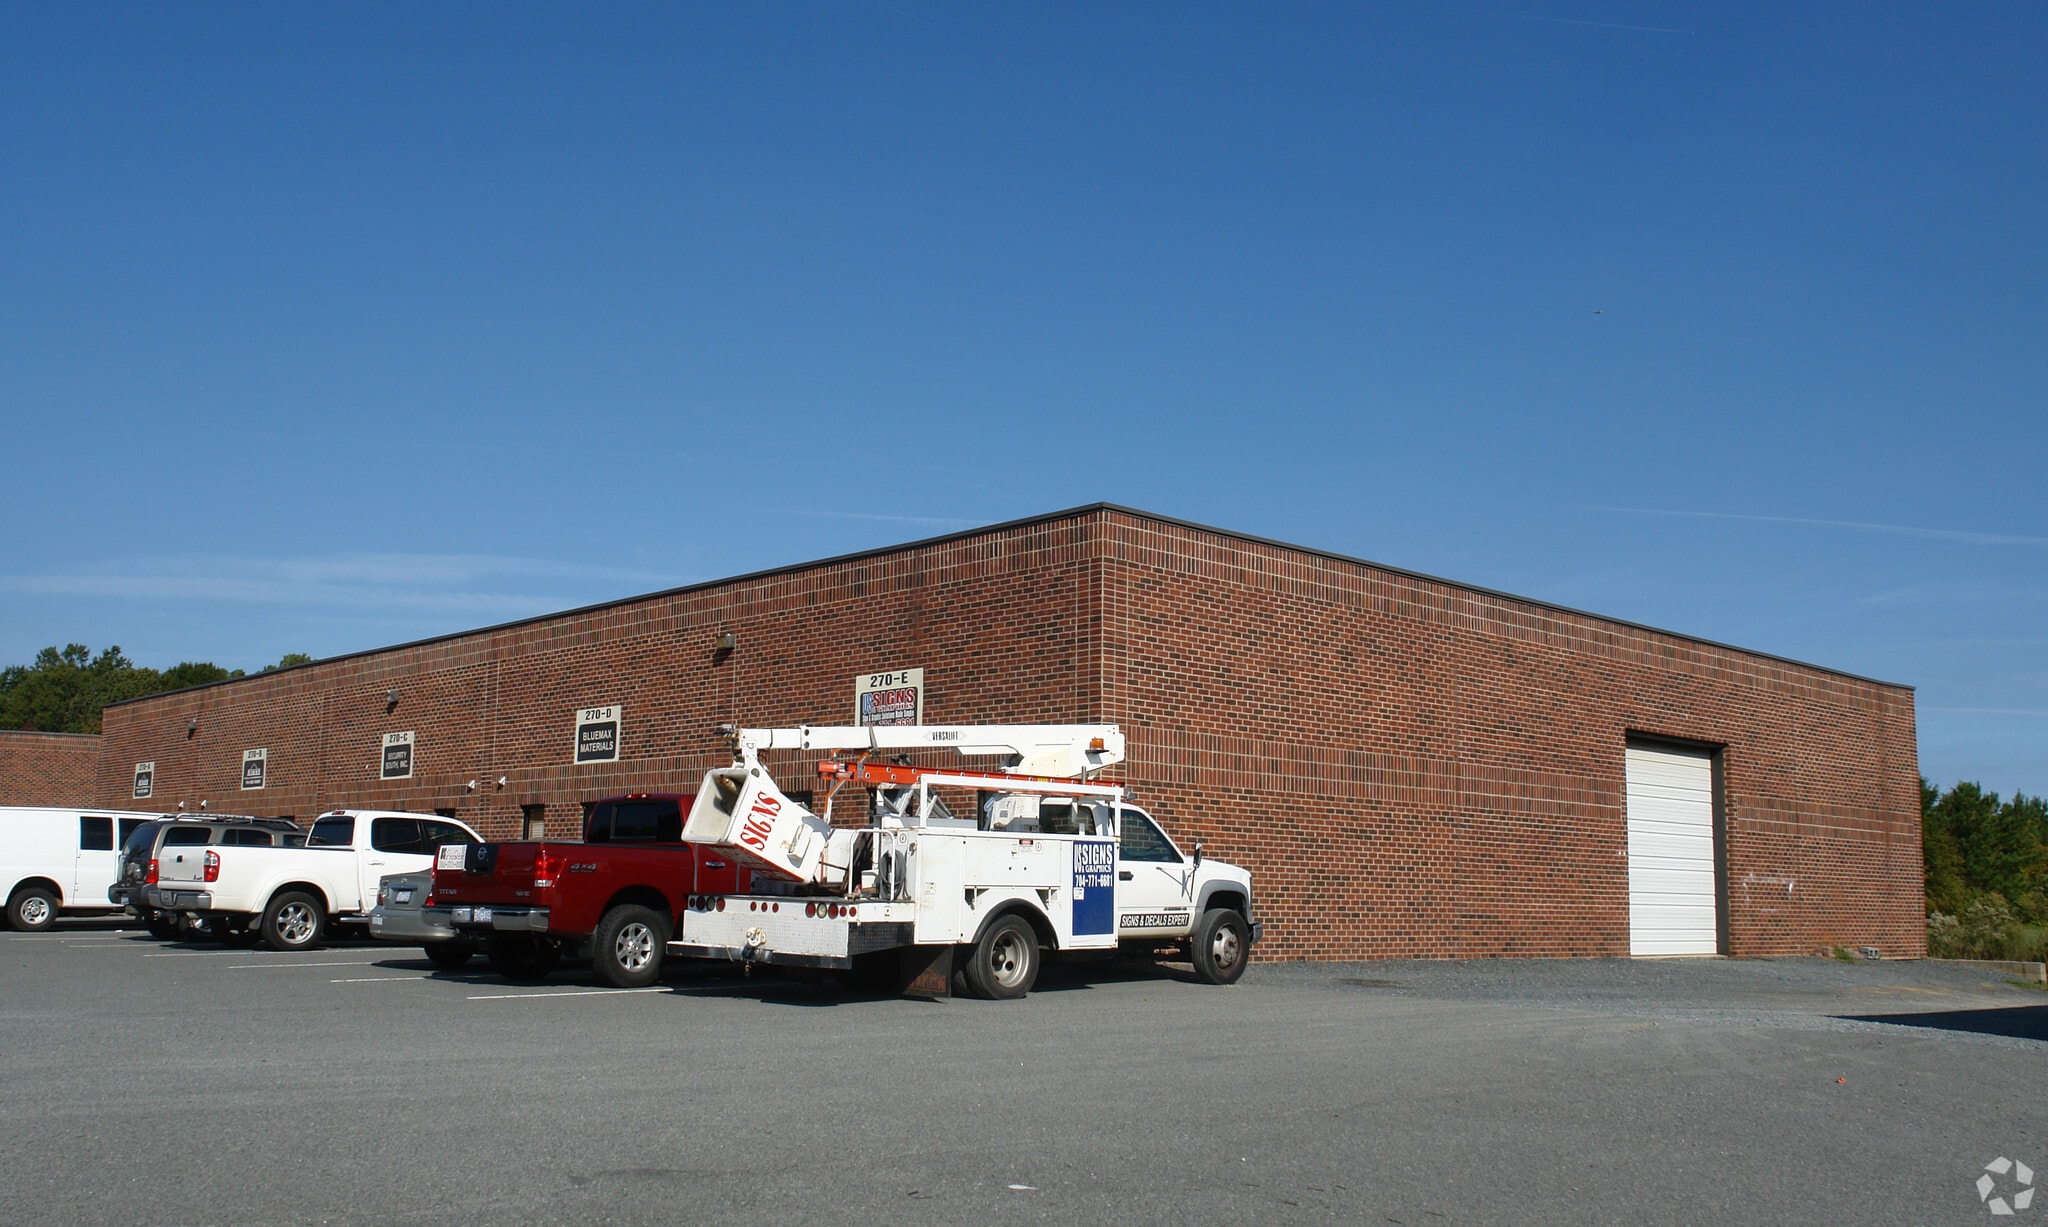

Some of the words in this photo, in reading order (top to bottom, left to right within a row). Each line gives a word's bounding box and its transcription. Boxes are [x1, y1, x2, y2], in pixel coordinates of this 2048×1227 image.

[870, 672, 908, 688] 270-E
[873, 688, 915, 707] SIGNS
[585, 708, 612, 720] 270-D
[389, 733, 408, 743] 270-C
[583, 730, 612, 740] BLUEMAX
[932, 731, 958, 741] VERSALIFT
[580, 741, 614, 752] MATERIALS
[740, 791, 781, 852] SIGNS
[1082, 844, 1113, 865] SIGNS
[1085, 865, 1112, 873] GRAPHICS
[1075, 874, 1113, 888] 704-771-6681
[1121, 915, 1139, 927] SIGNS
[1140, 915, 1144, 927] &
[1144, 915, 1167, 927] DECALS
[1167, 914, 1189, 926] EXPERT
